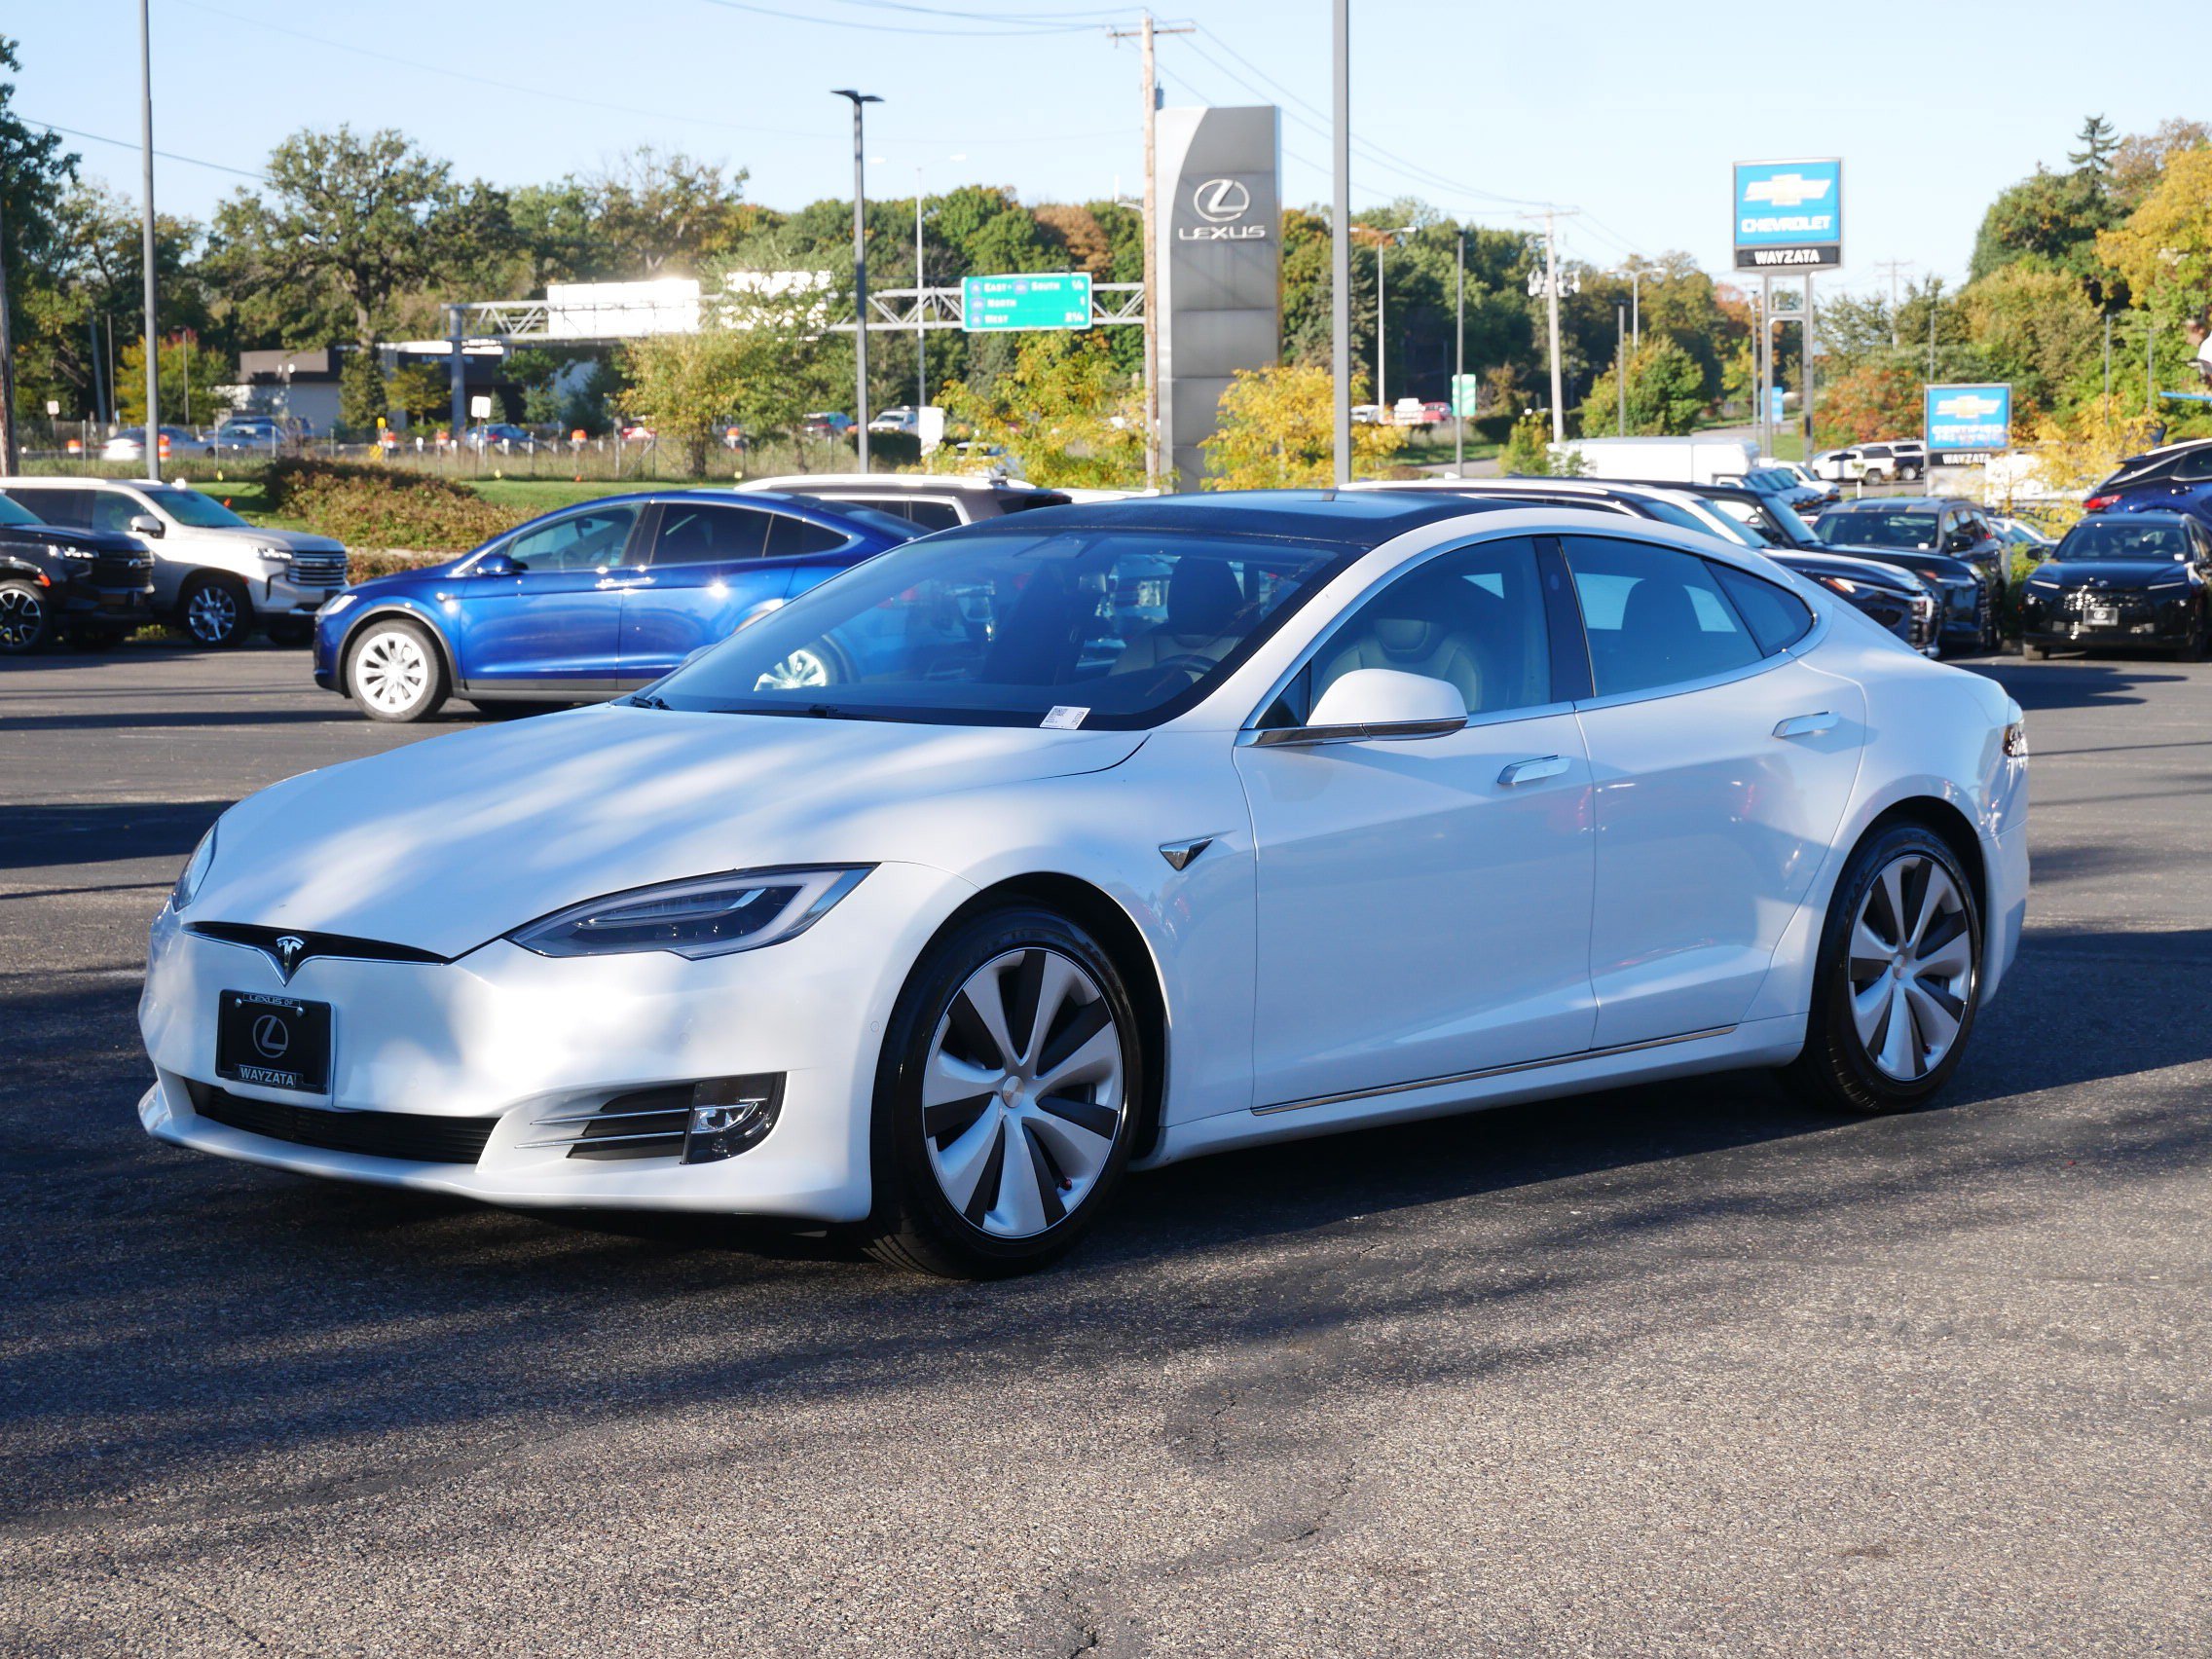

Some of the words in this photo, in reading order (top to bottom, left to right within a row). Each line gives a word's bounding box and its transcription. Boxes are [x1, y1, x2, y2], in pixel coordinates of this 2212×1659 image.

[1741, 215, 1831, 233] CHEVROLET
[1178, 225, 1266, 240] LEXUS
[1753, 249, 1821, 265] WAYZATA
[248, 993, 282, 1006] LEXUS
[240, 1067, 294, 1087] WAYZATA
